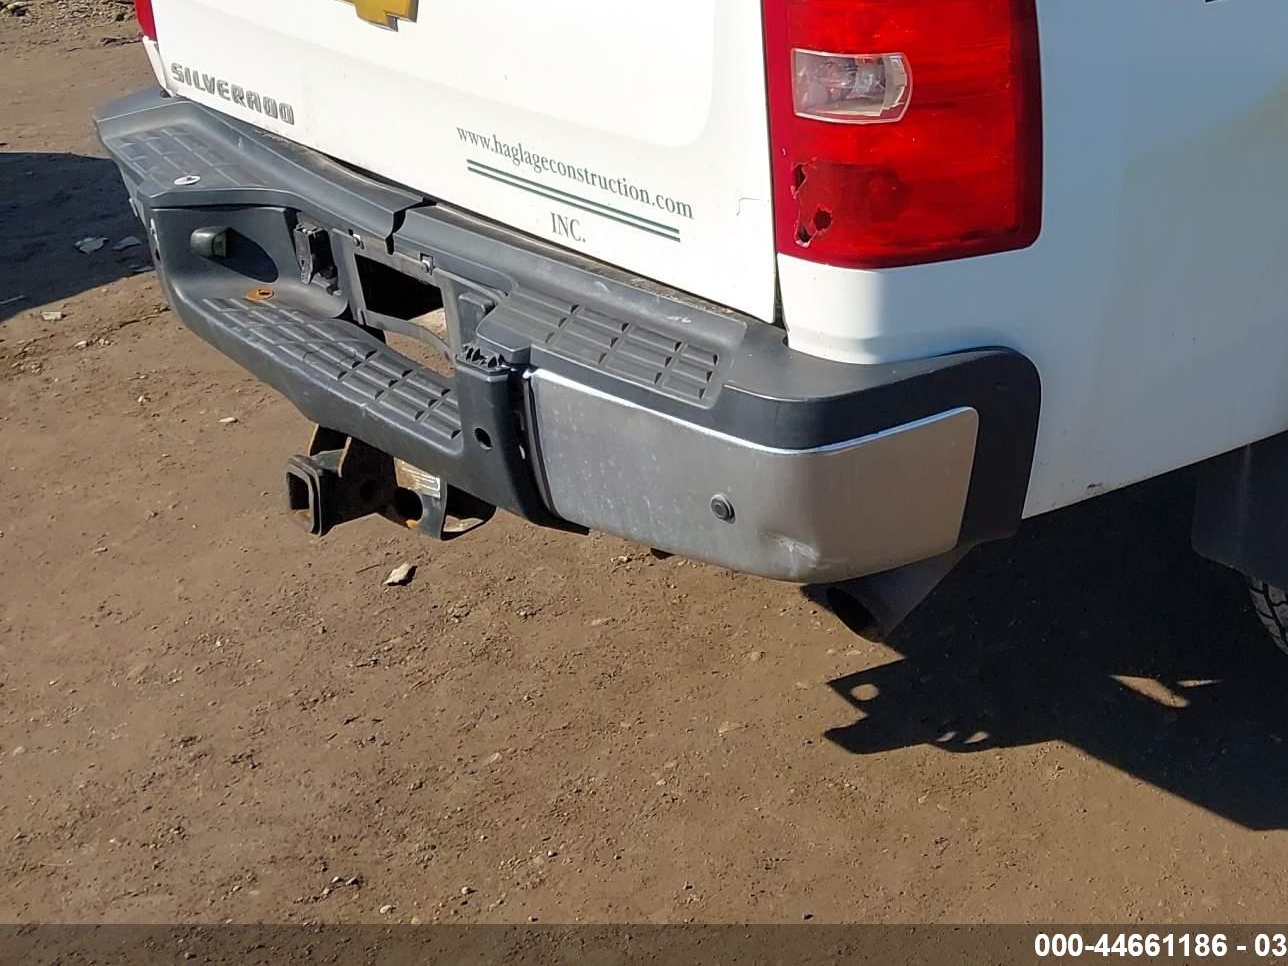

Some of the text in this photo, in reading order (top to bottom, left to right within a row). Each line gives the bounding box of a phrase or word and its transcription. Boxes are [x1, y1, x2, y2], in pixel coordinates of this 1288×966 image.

[170, 62, 295, 126] SILVERADO
[456, 127, 695, 220] www.haglageconstruction.com
[551, 212, 587, 243] INC.
